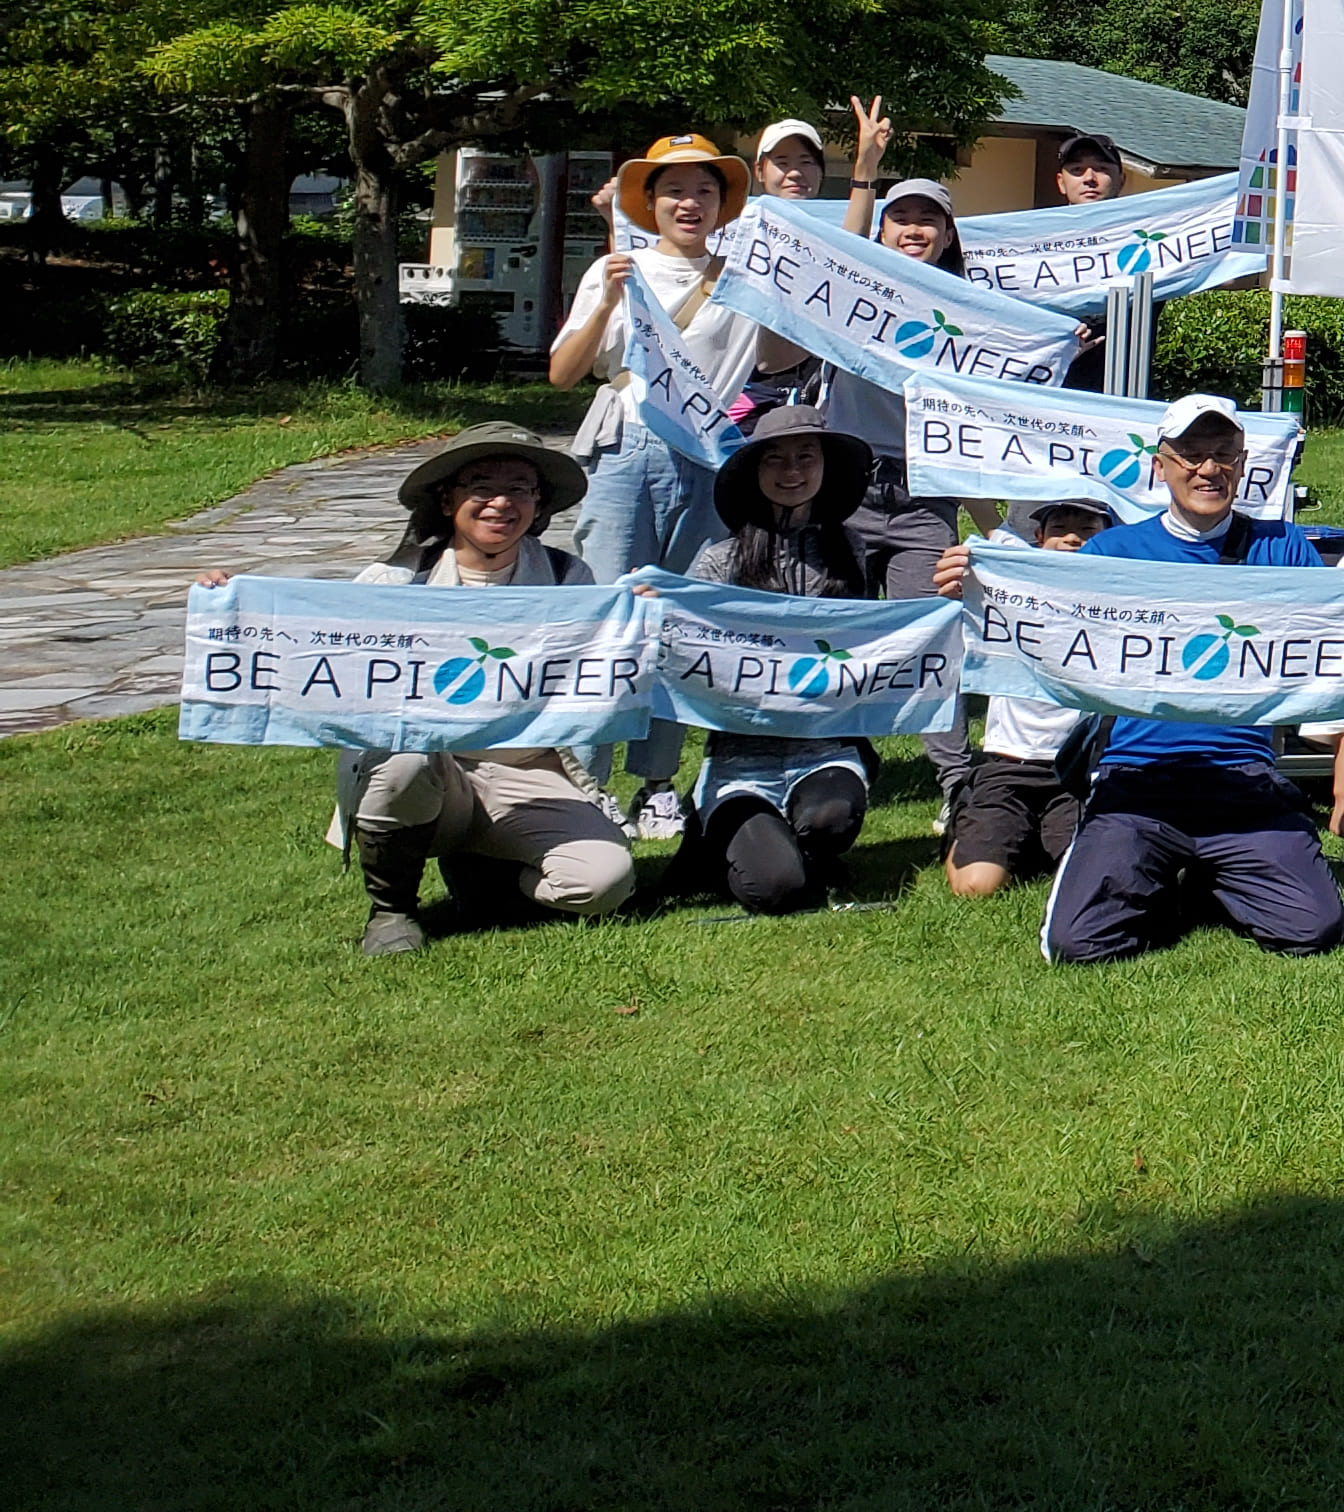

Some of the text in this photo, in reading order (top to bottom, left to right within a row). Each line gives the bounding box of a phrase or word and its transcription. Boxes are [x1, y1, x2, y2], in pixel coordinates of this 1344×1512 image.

[746, 239, 802, 295] BE
[805, 280, 831, 317] A
[966, 264, 1020, 291] BE
[1034, 261, 1060, 288] A
[651, 367, 673, 402] A
[922, 397, 1097, 438] 期待の先へ、次世代の笑顔へ
[924, 420, 984, 459] BE
[1002, 434, 1032, 465] A
[208, 625, 430, 649] 期待の先へ、次世代の笑顔へ
[983, 605, 1045, 662] BE
[1062, 629, 1097, 670] A
[205, 651, 639, 705] BE A PIONEER
[680, 651, 713, 688] A
[734, 653, 947, 698] PIONEER
